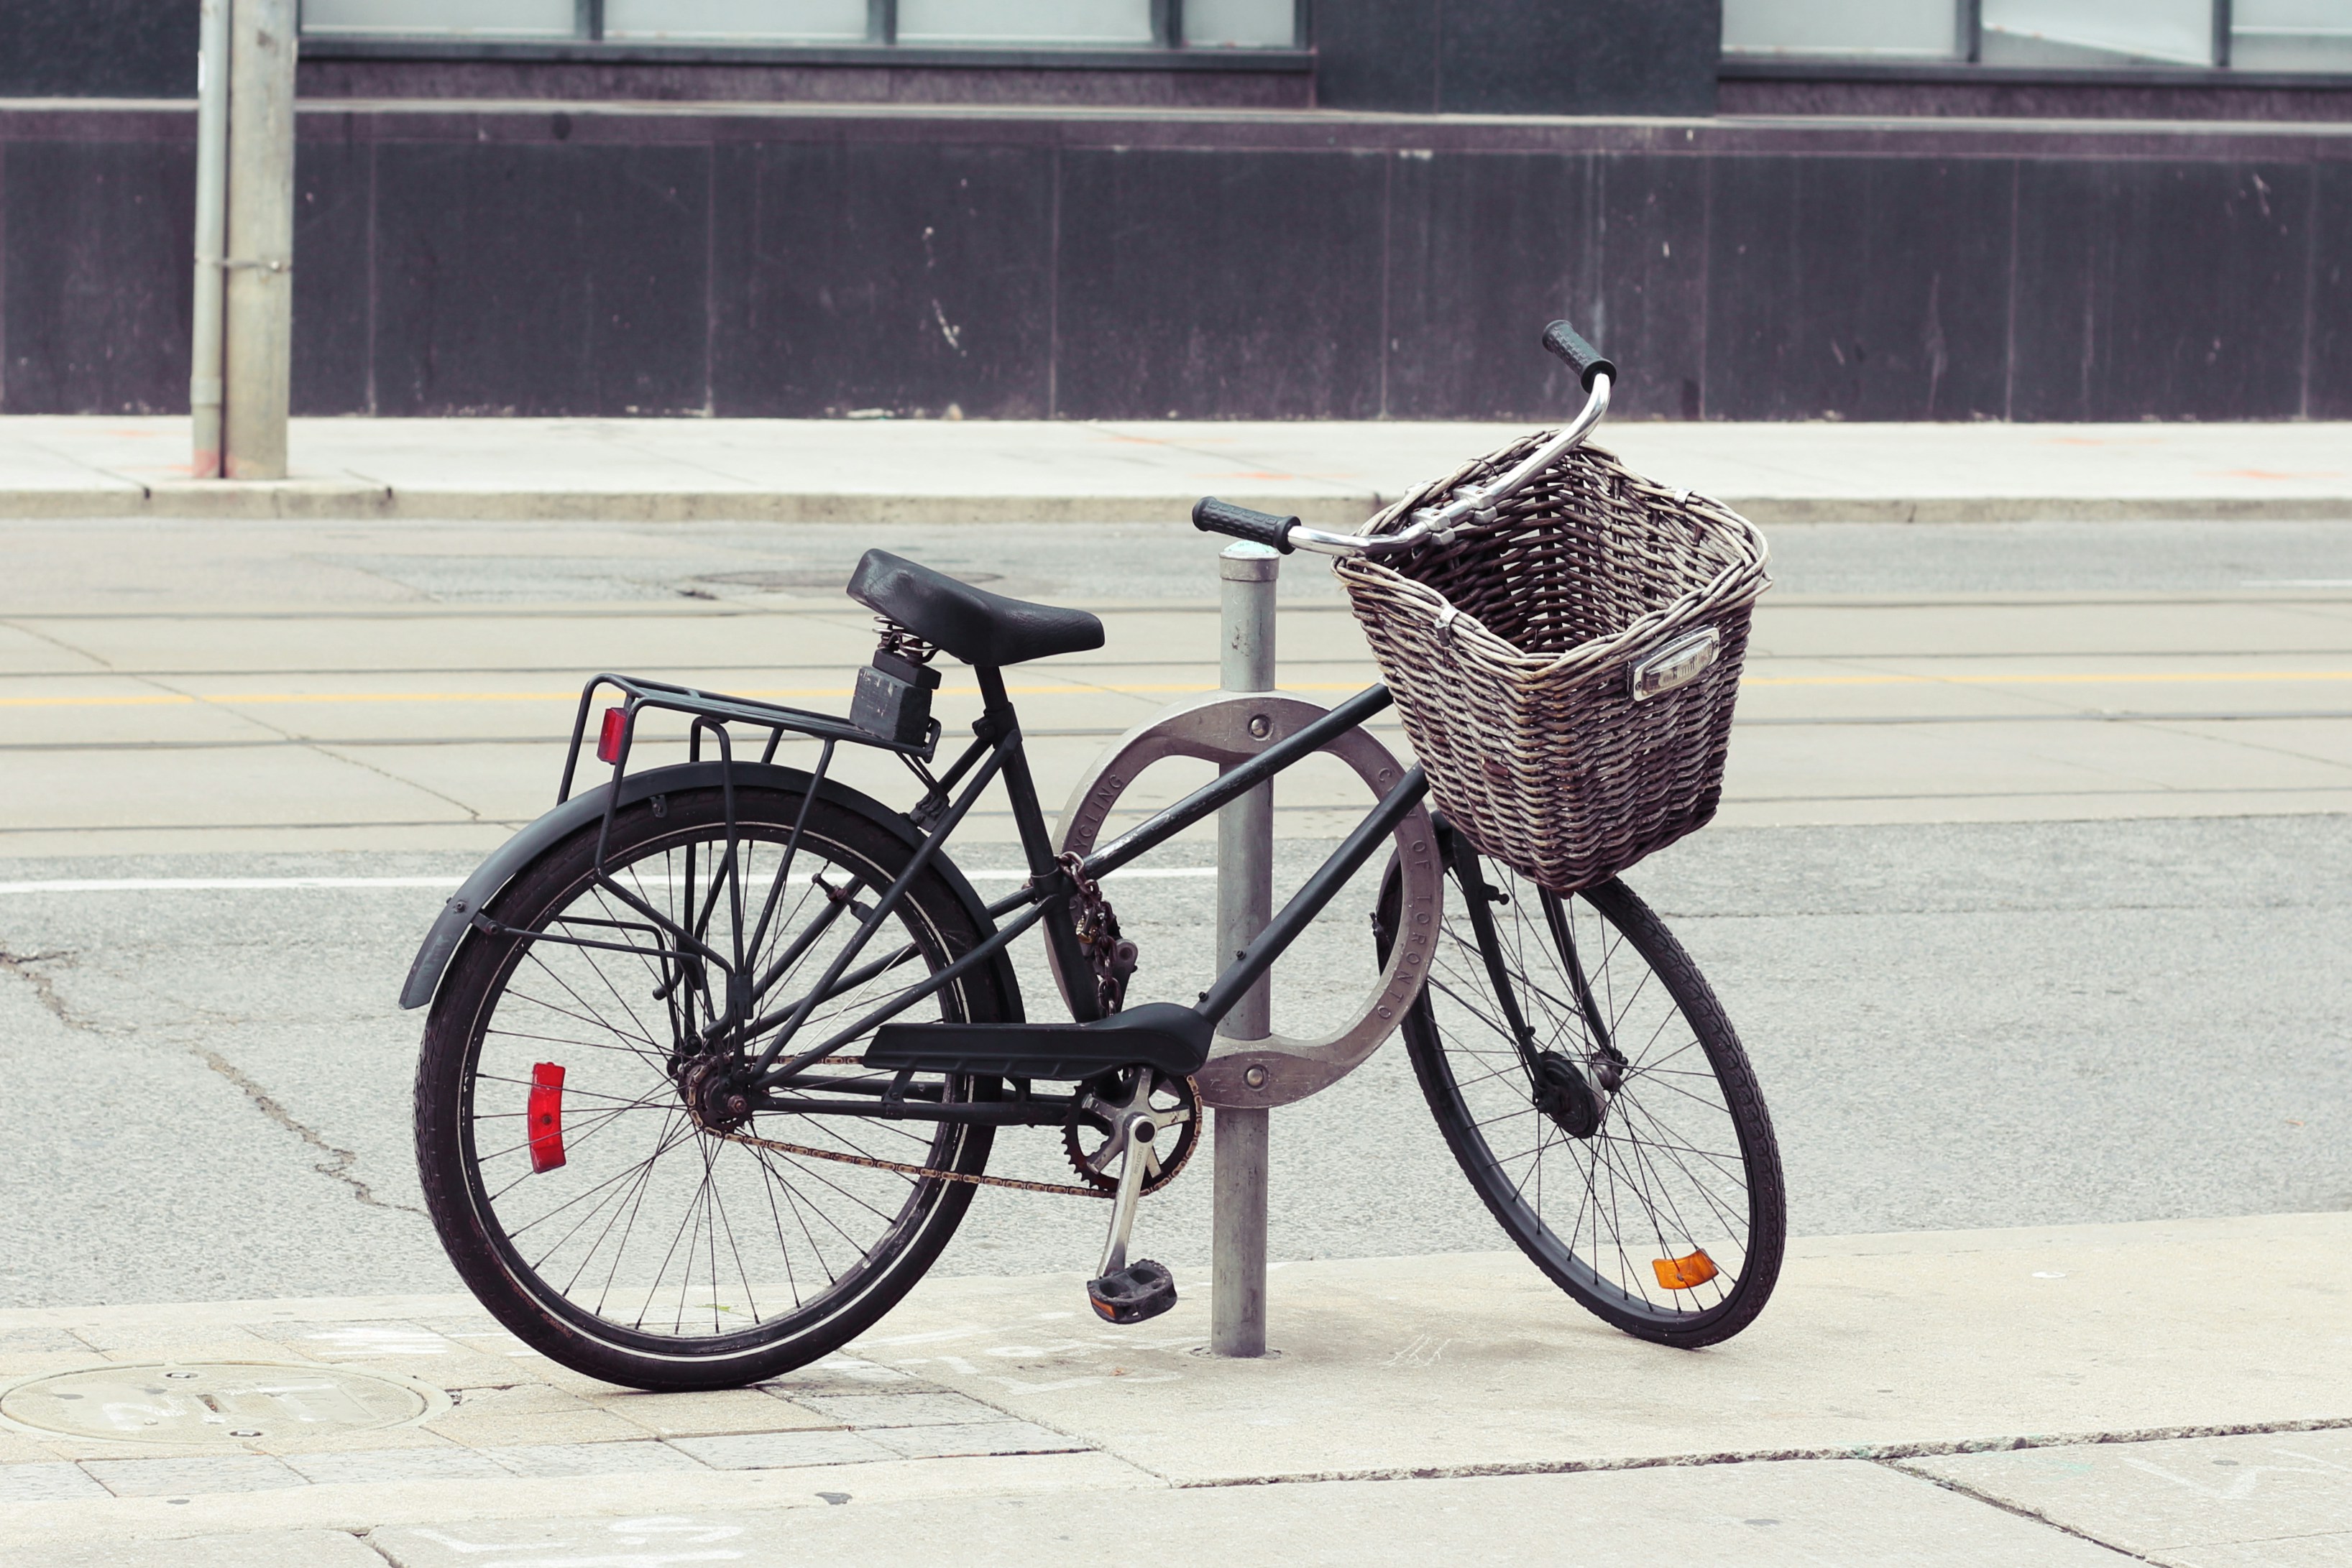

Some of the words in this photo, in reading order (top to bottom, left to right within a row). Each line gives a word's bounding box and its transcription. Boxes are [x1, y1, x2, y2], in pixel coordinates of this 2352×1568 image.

[1072, 774, 1124, 850] YCLING
[1411, 839, 1432, 870] OF
[1377, 893, 1433, 1019] TORONTO
